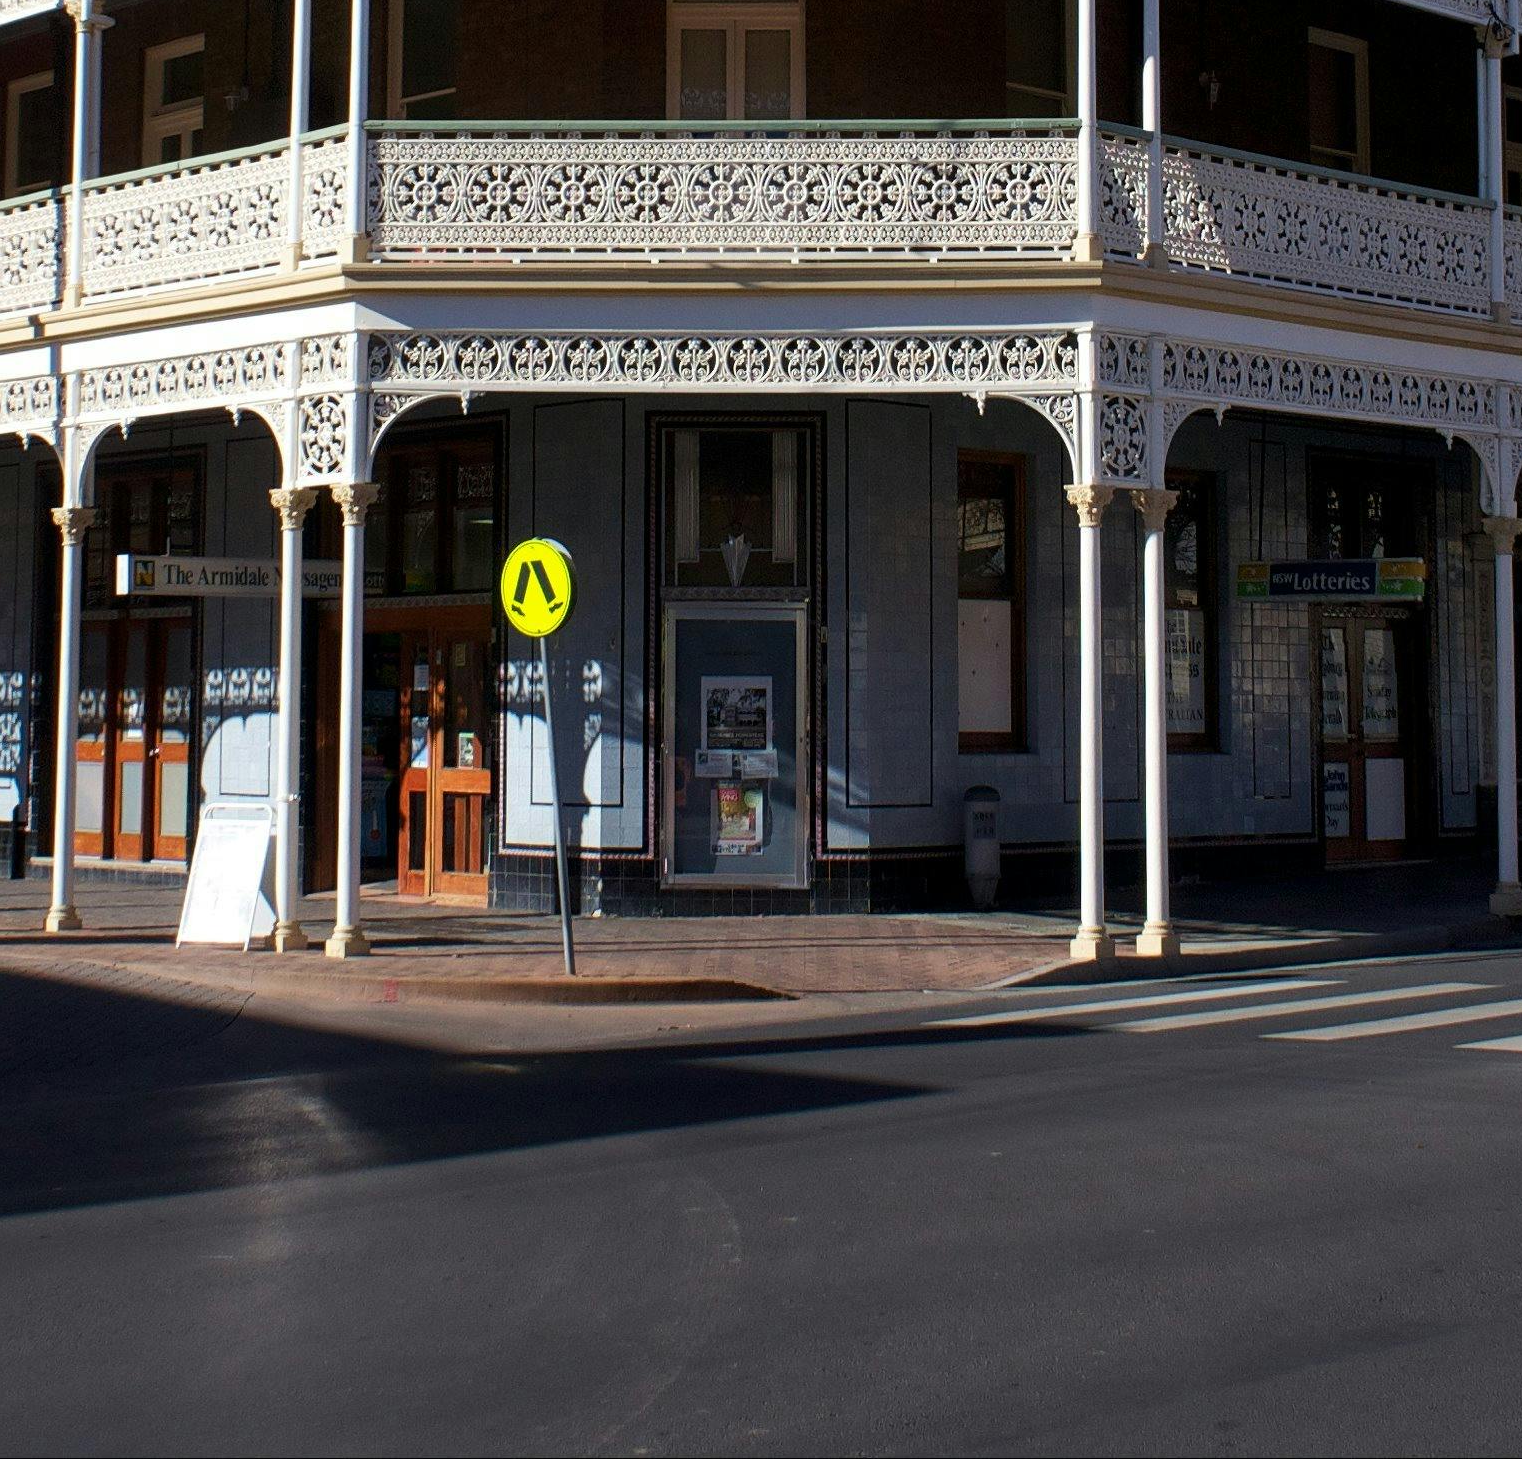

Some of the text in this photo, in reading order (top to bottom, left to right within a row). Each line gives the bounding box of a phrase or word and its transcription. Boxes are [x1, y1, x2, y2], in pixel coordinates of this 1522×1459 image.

[164, 564, 193, 586] The
[199, 564, 269, 587] Armidale
[1272, 571, 1371, 591] NSW Lotteries
[1167, 708, 1204, 721] RALIAN
